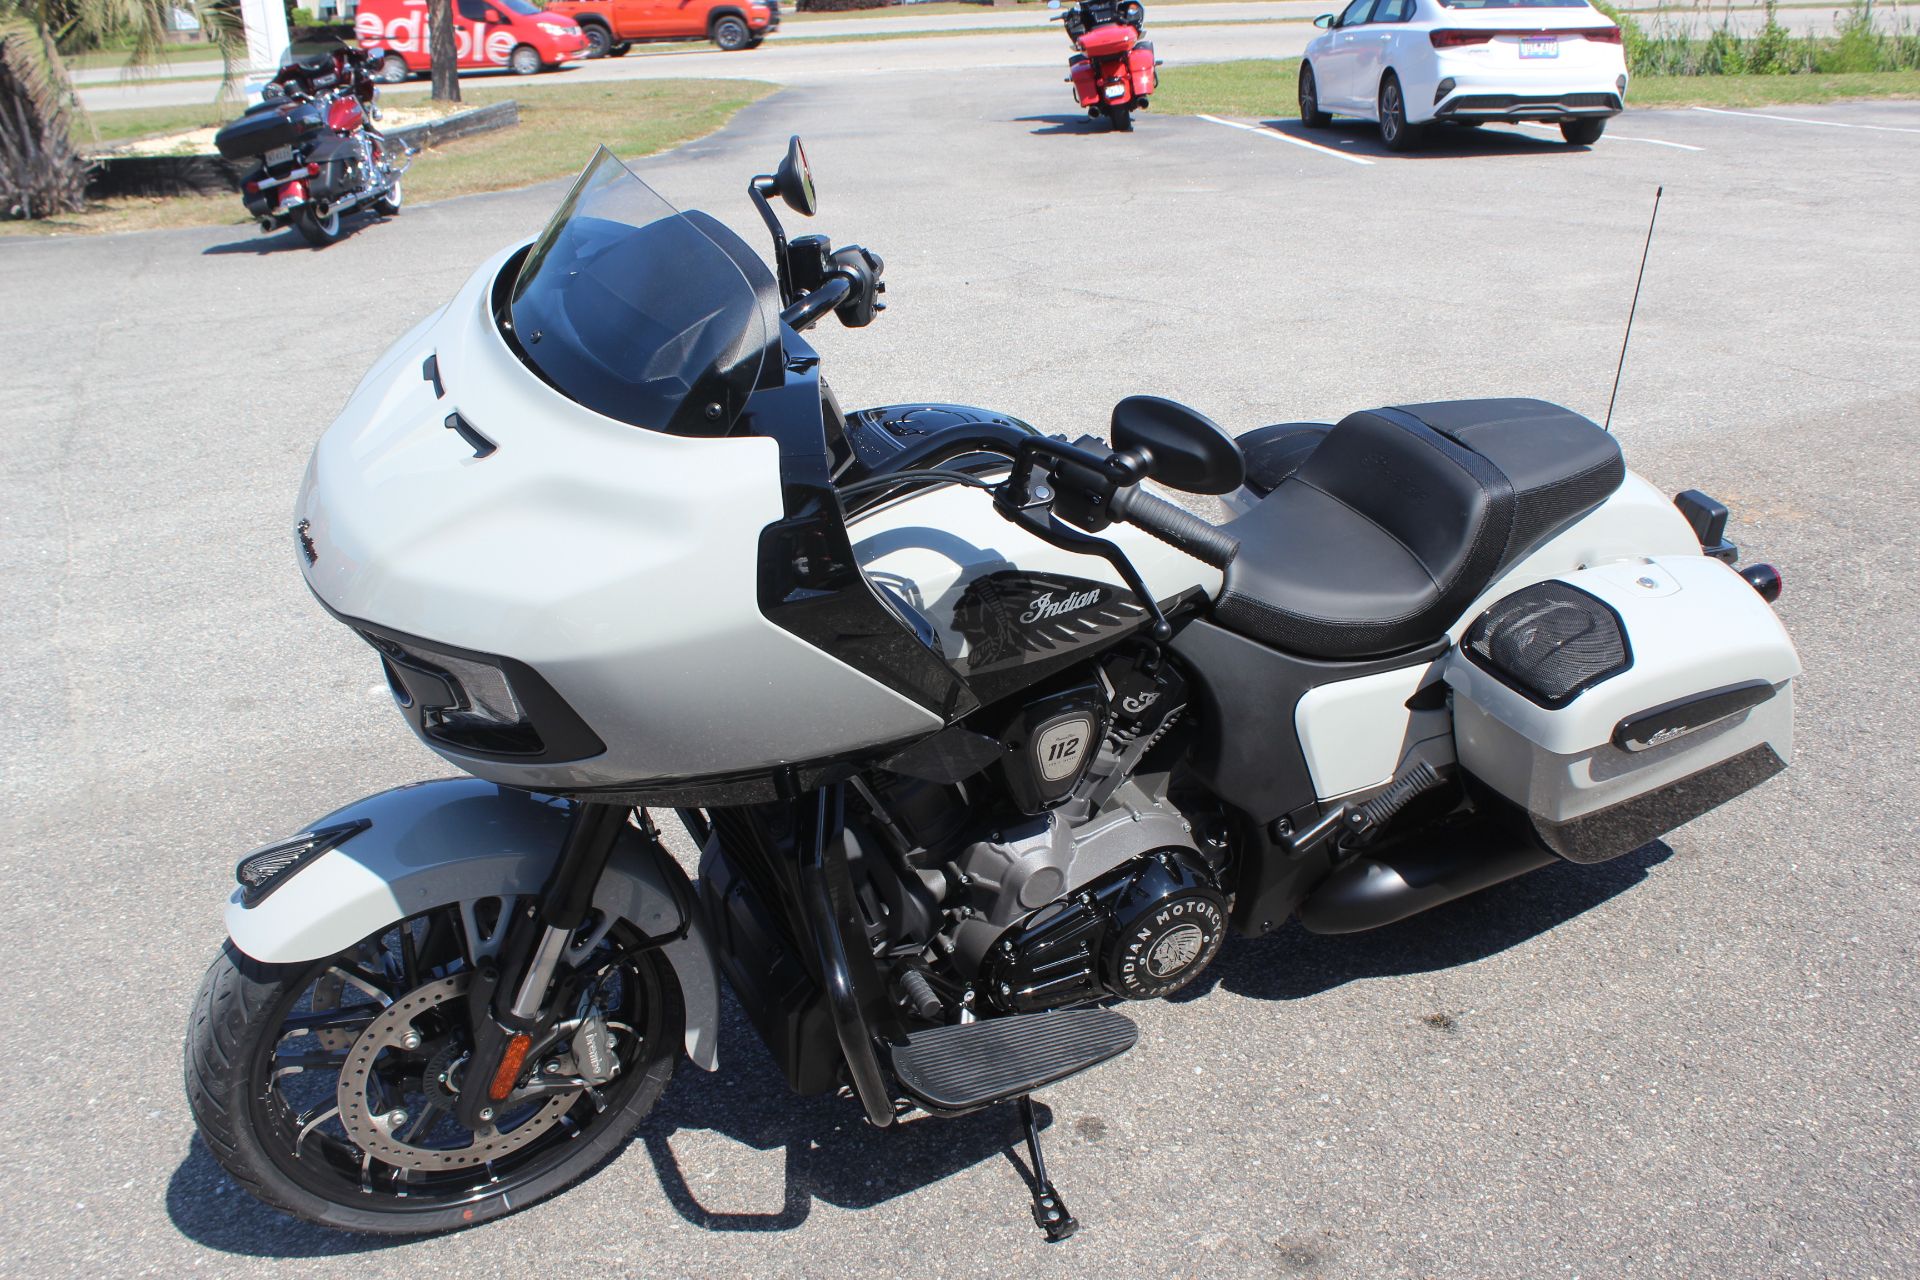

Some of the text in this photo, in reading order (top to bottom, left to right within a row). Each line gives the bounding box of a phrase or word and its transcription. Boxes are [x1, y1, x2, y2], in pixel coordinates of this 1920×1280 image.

[1020, 588, 1101, 624] Indian
[1048, 737, 1080, 762] 112
[1123, 927, 1152, 989] INDIAN
[1156, 901, 1222, 963] MOTORCYCLE
